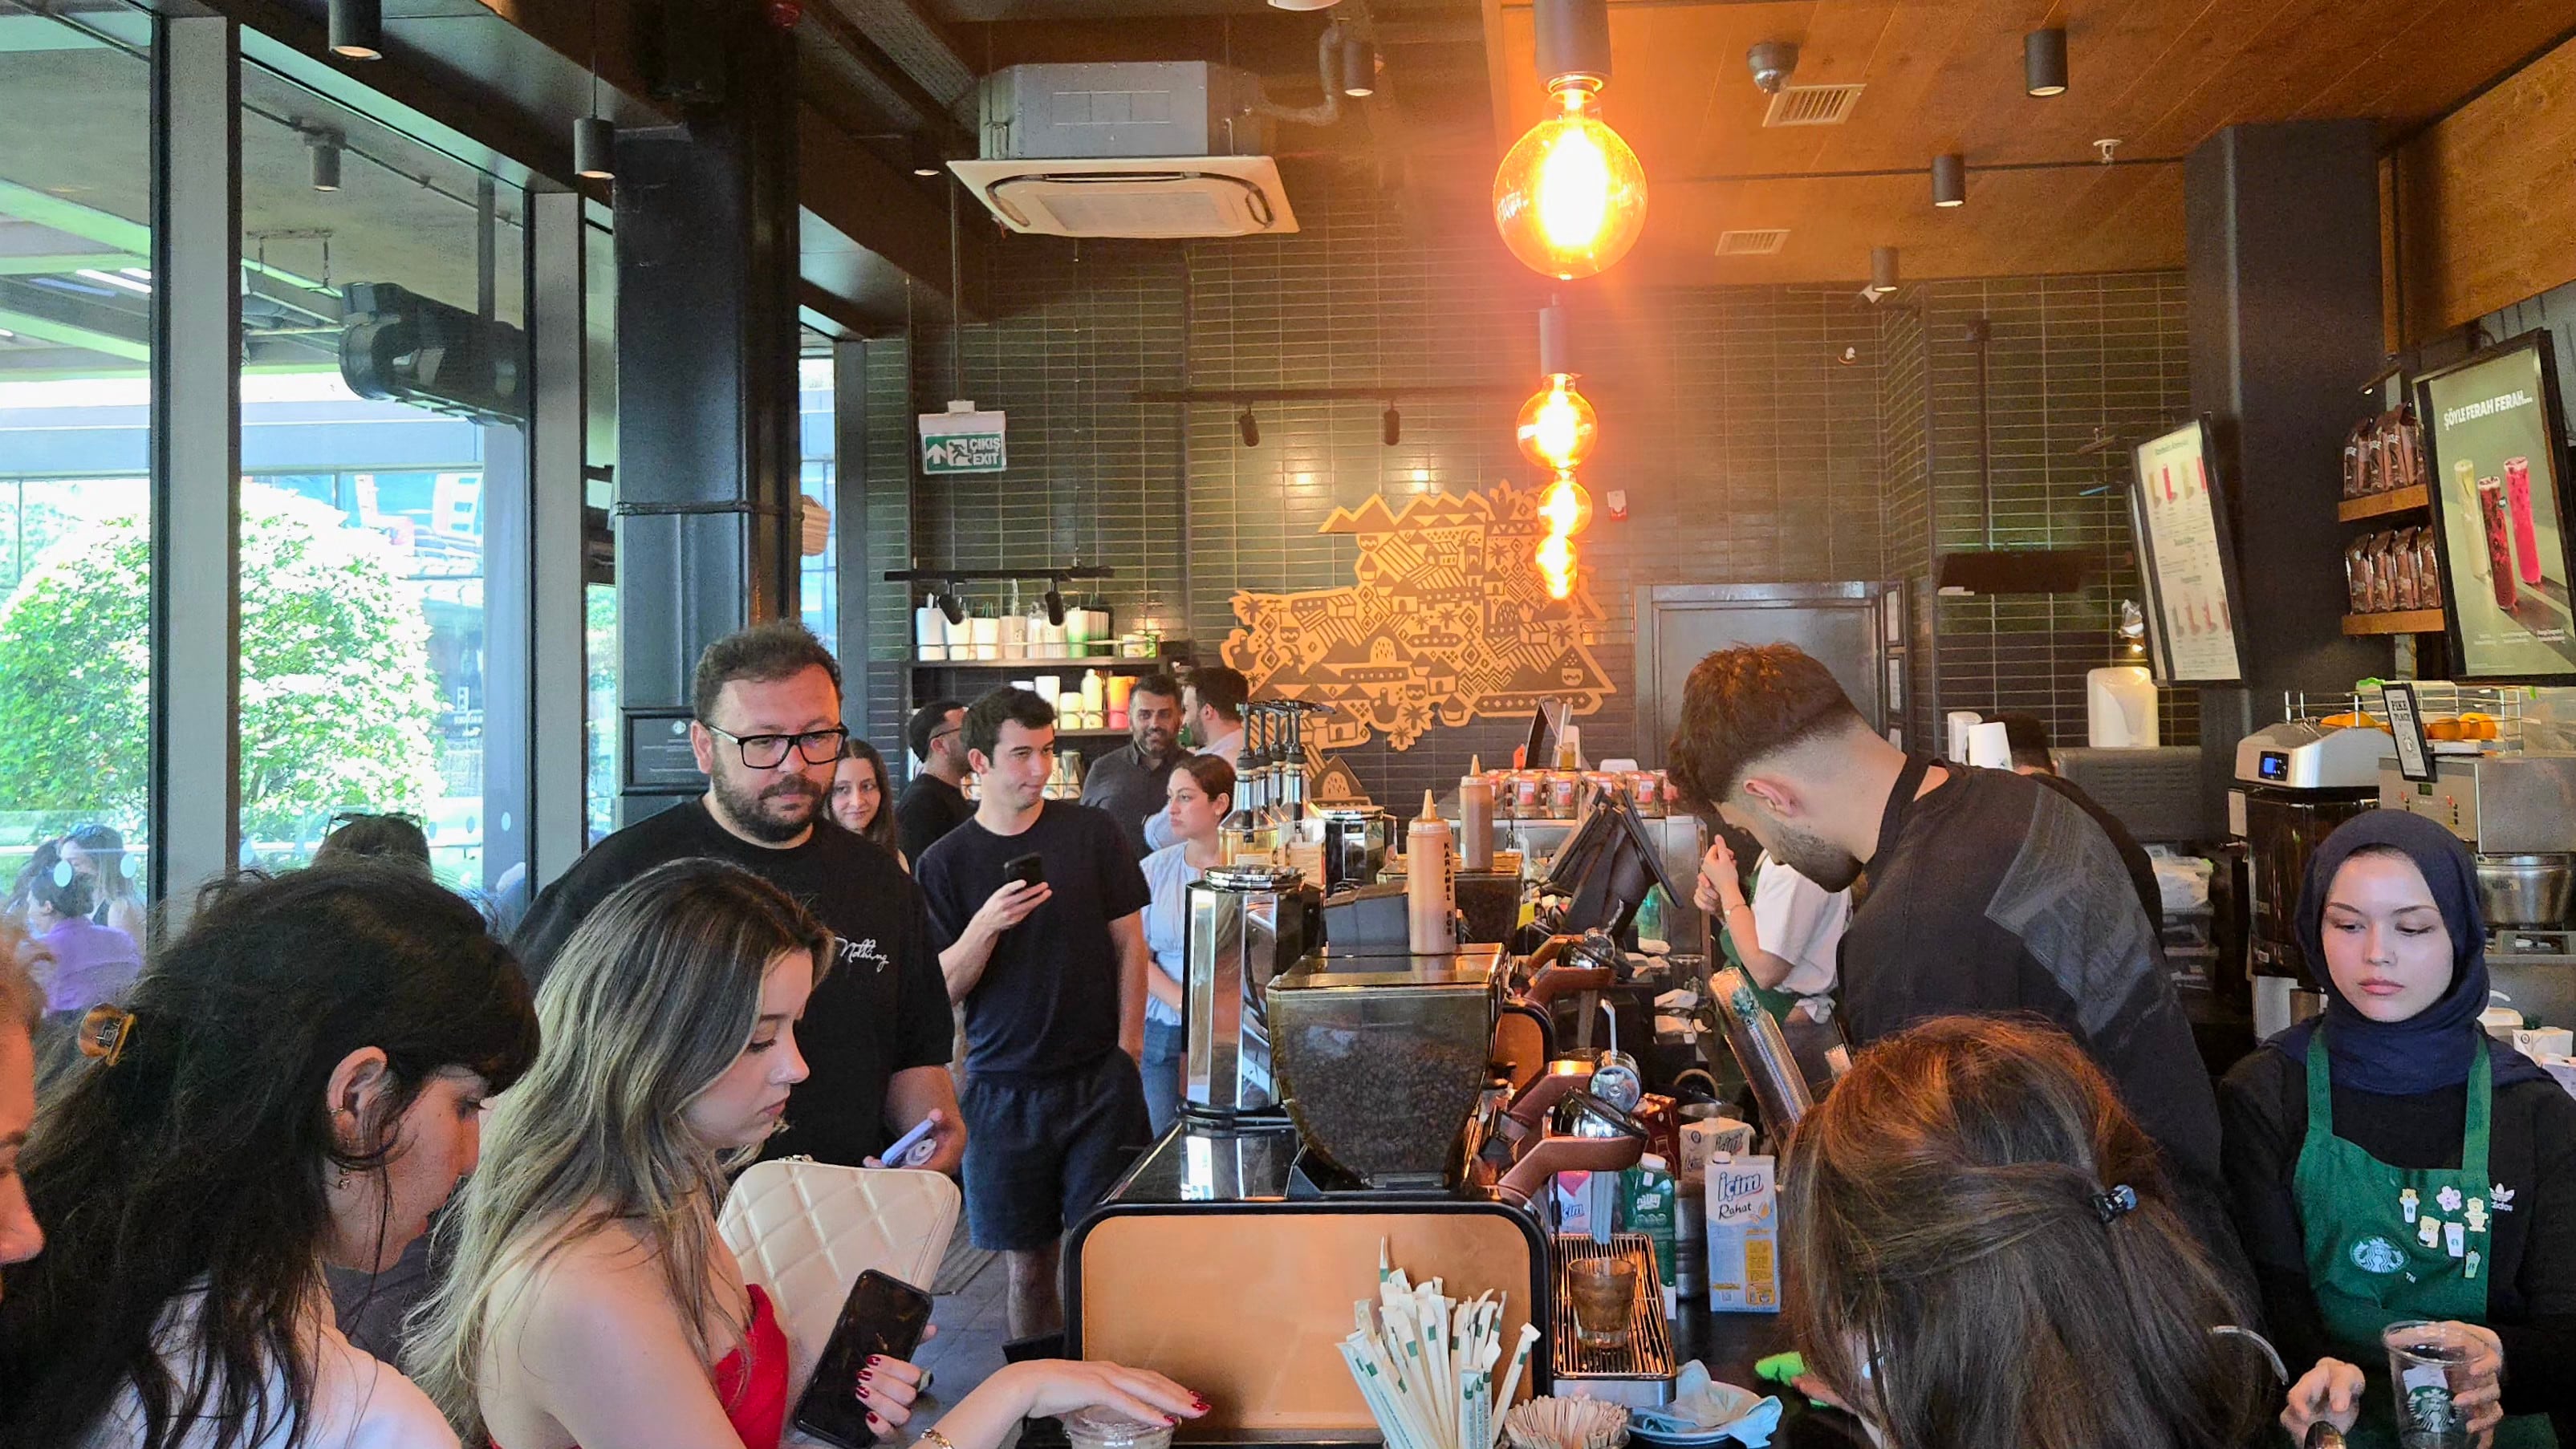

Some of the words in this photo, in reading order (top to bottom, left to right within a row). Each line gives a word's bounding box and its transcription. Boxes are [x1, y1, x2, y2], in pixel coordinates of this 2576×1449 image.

[2444, 408, 2466, 431] ŞÖYLE
[2465, 399, 2494, 420] FERAH
[969, 437, 1001, 453] ÇIKIŞ
[973, 453, 999, 465] EXIT
[1444, 842, 1452, 901] KARAMEL
[1717, 1171, 1762, 1202] İçim
[1562, 1202, 1584, 1221] çim
[1718, 1203, 1752, 1220] Rahat
